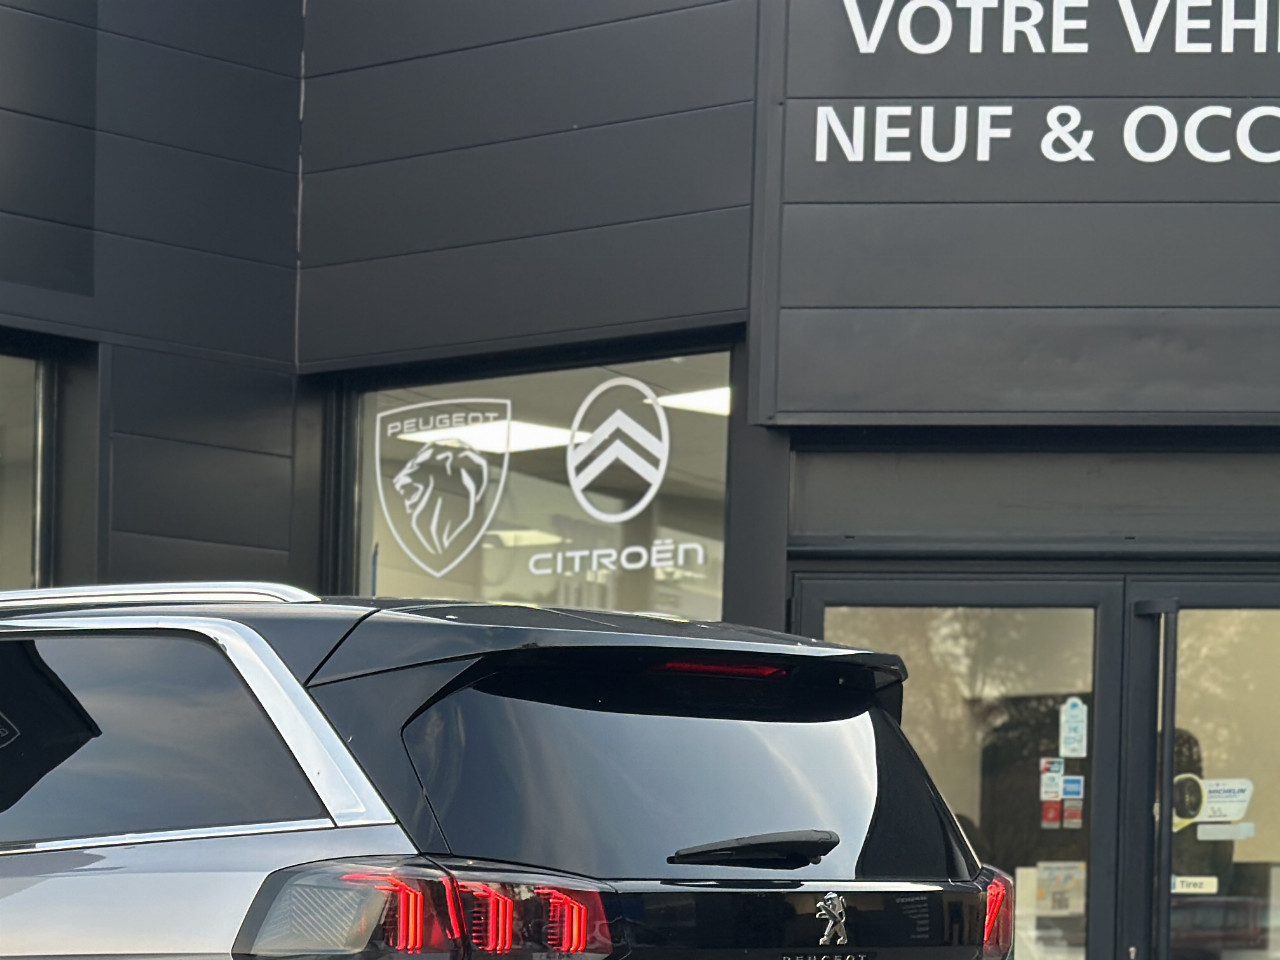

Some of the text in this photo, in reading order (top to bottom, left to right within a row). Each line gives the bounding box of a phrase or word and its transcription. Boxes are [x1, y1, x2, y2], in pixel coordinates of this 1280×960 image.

[843, 0, 1280, 54] VOTRE VEH
[815, 104, 1280, 163] NEUF & OCC
[387, 412, 499, 437] PEUGEOT
[1179, 880, 1204, 889] Tirez
